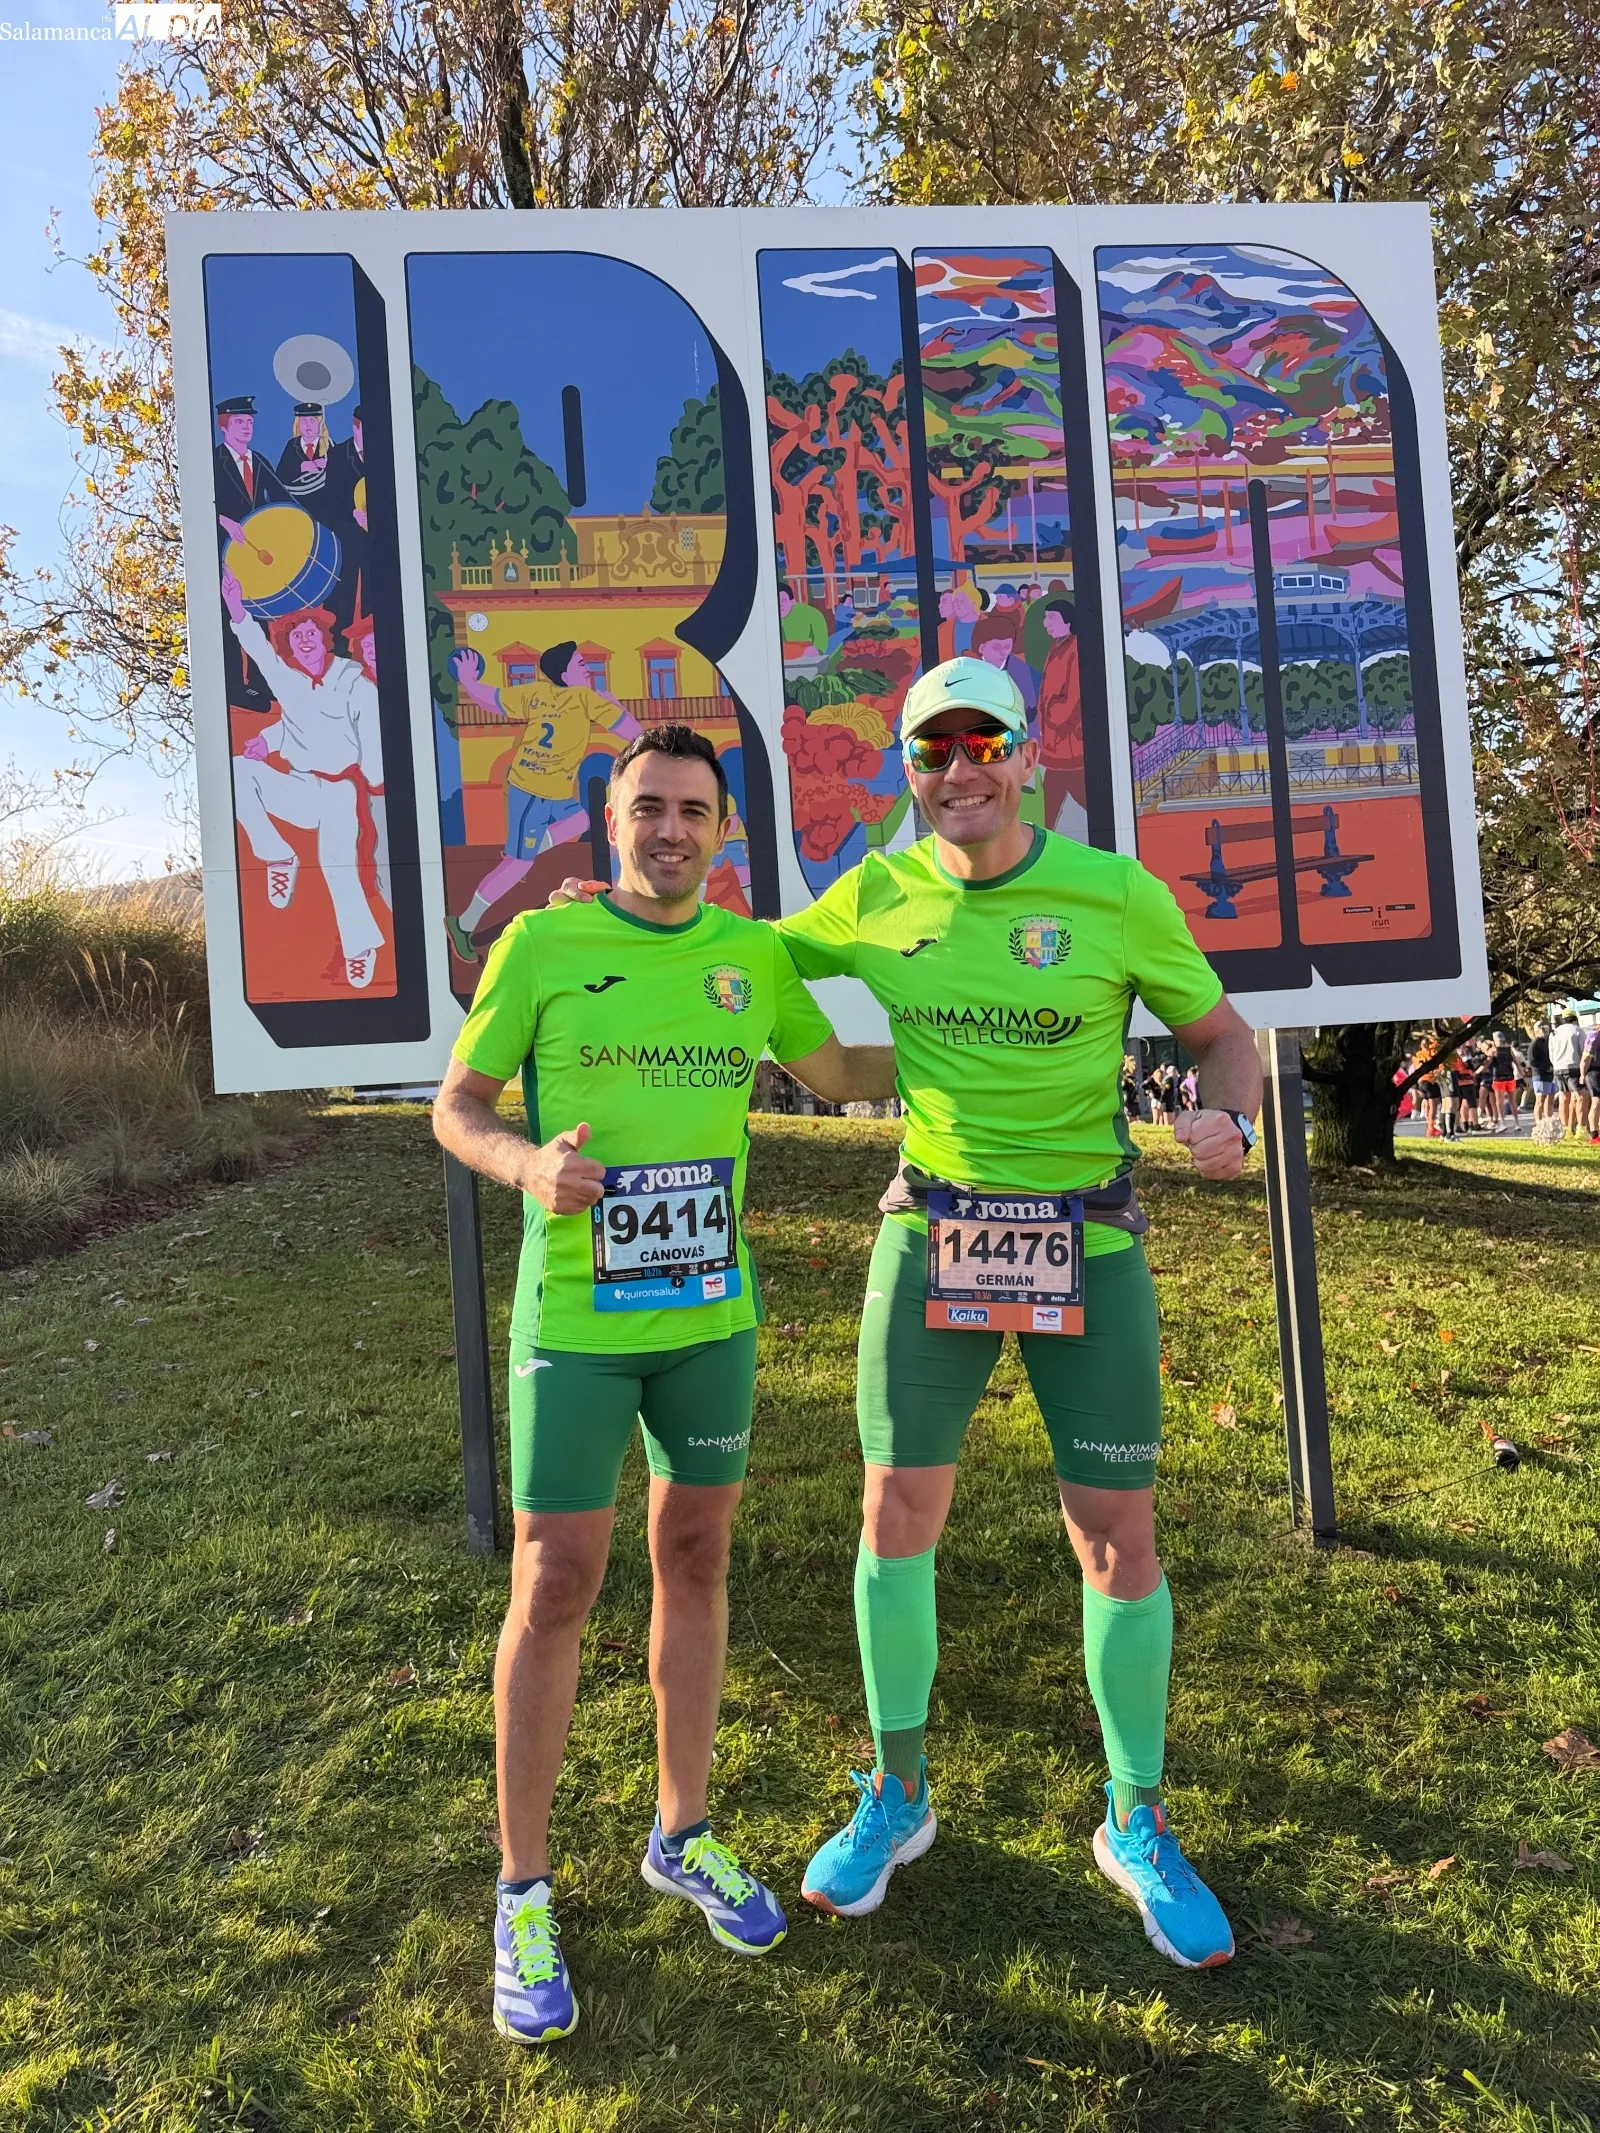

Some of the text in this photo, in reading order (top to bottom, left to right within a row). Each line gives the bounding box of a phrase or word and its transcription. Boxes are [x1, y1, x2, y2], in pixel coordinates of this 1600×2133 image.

[538, 722, 555, 749] 2
[892, 1003, 1059, 1029] SANMAXIMO
[937, 1028, 1045, 1045] TELECOM
[580, 1045, 746, 1067] SANMAXIMO
[637, 1068, 734, 1088] TELECOM
[608, 1194, 727, 1245] 9414
[640, 1245, 705, 1262] CÁNOVAS
[944, 1229, 1069, 1267] 14476
[976, 1272, 1034, 1287] GERMÁN
[950, 1308, 985, 1321] Kaiku
[1073, 1438, 1158, 1454] SANMAXIMO
[1103, 1452, 1153, 1463] TELECOM
